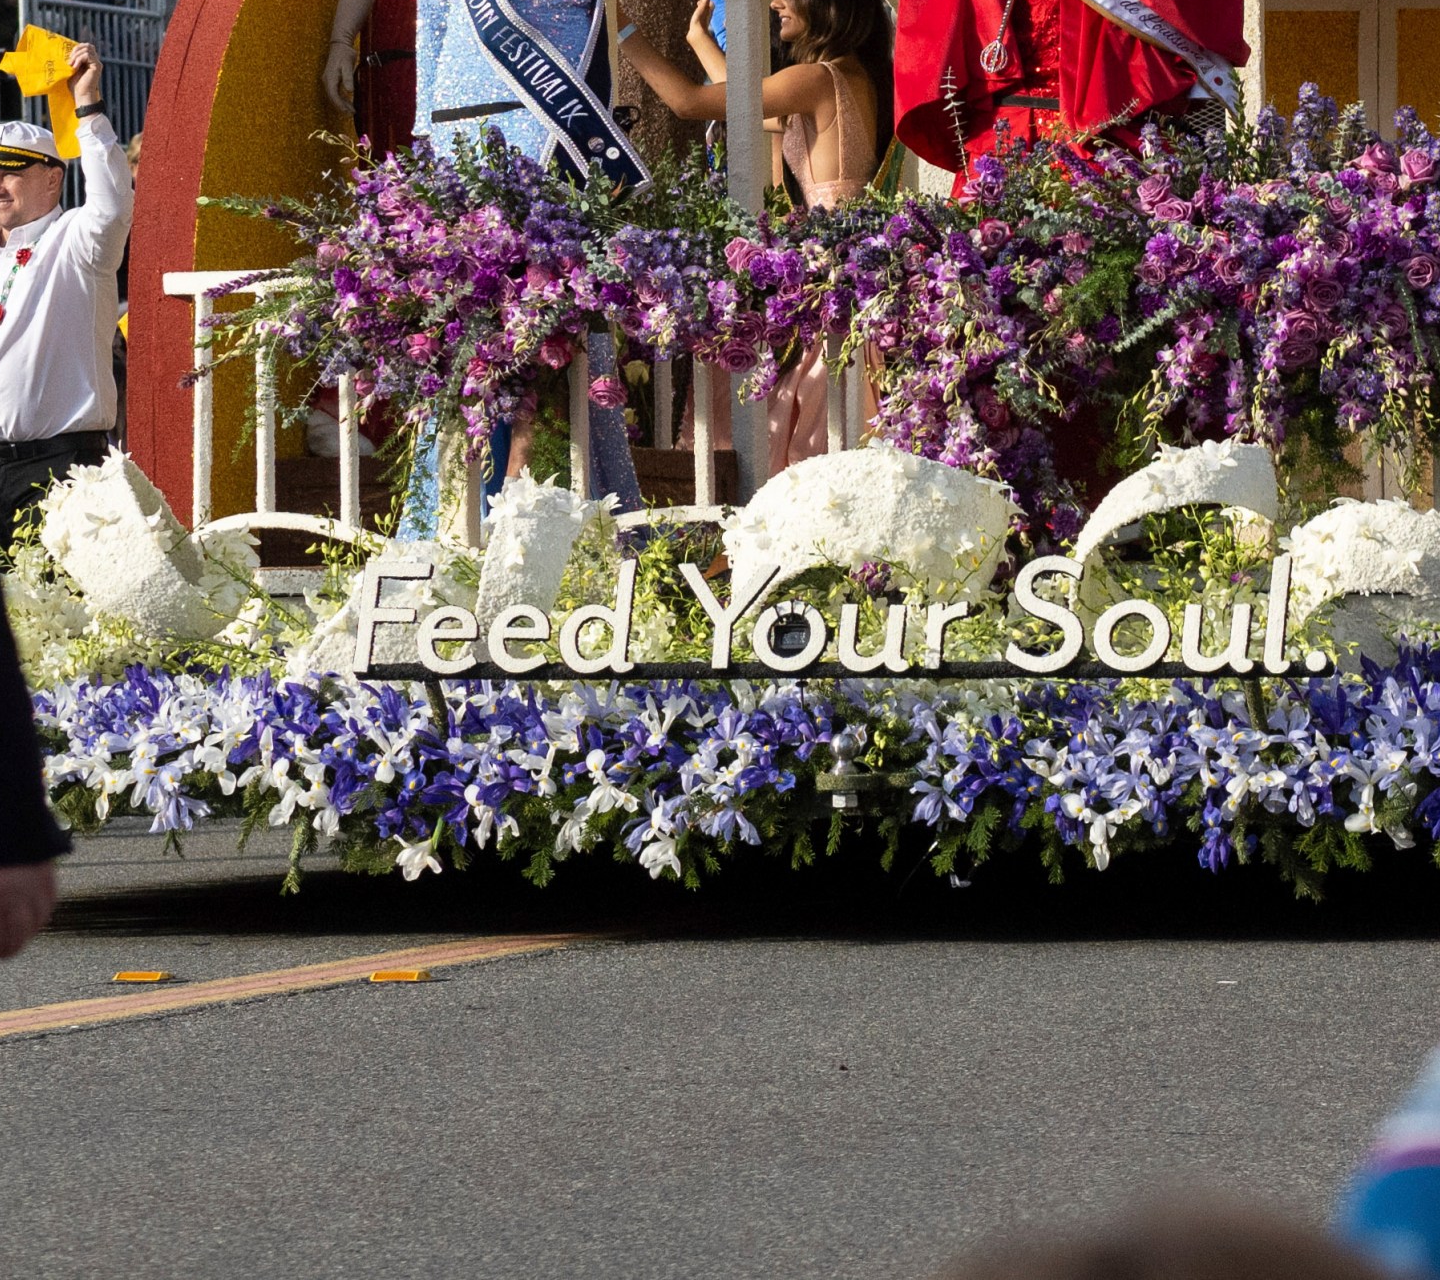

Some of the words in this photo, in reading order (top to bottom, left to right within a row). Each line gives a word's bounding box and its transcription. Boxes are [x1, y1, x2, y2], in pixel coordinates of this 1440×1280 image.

[1120, 0, 1140, 14] de
[491, 26, 568, 104] FESTIVAL
[557, 98, 589, 128] IX
[352, 558, 636, 676] Feed
[678, 560, 970, 675] Your
[1005, 553, 1330, 677] Soul.
